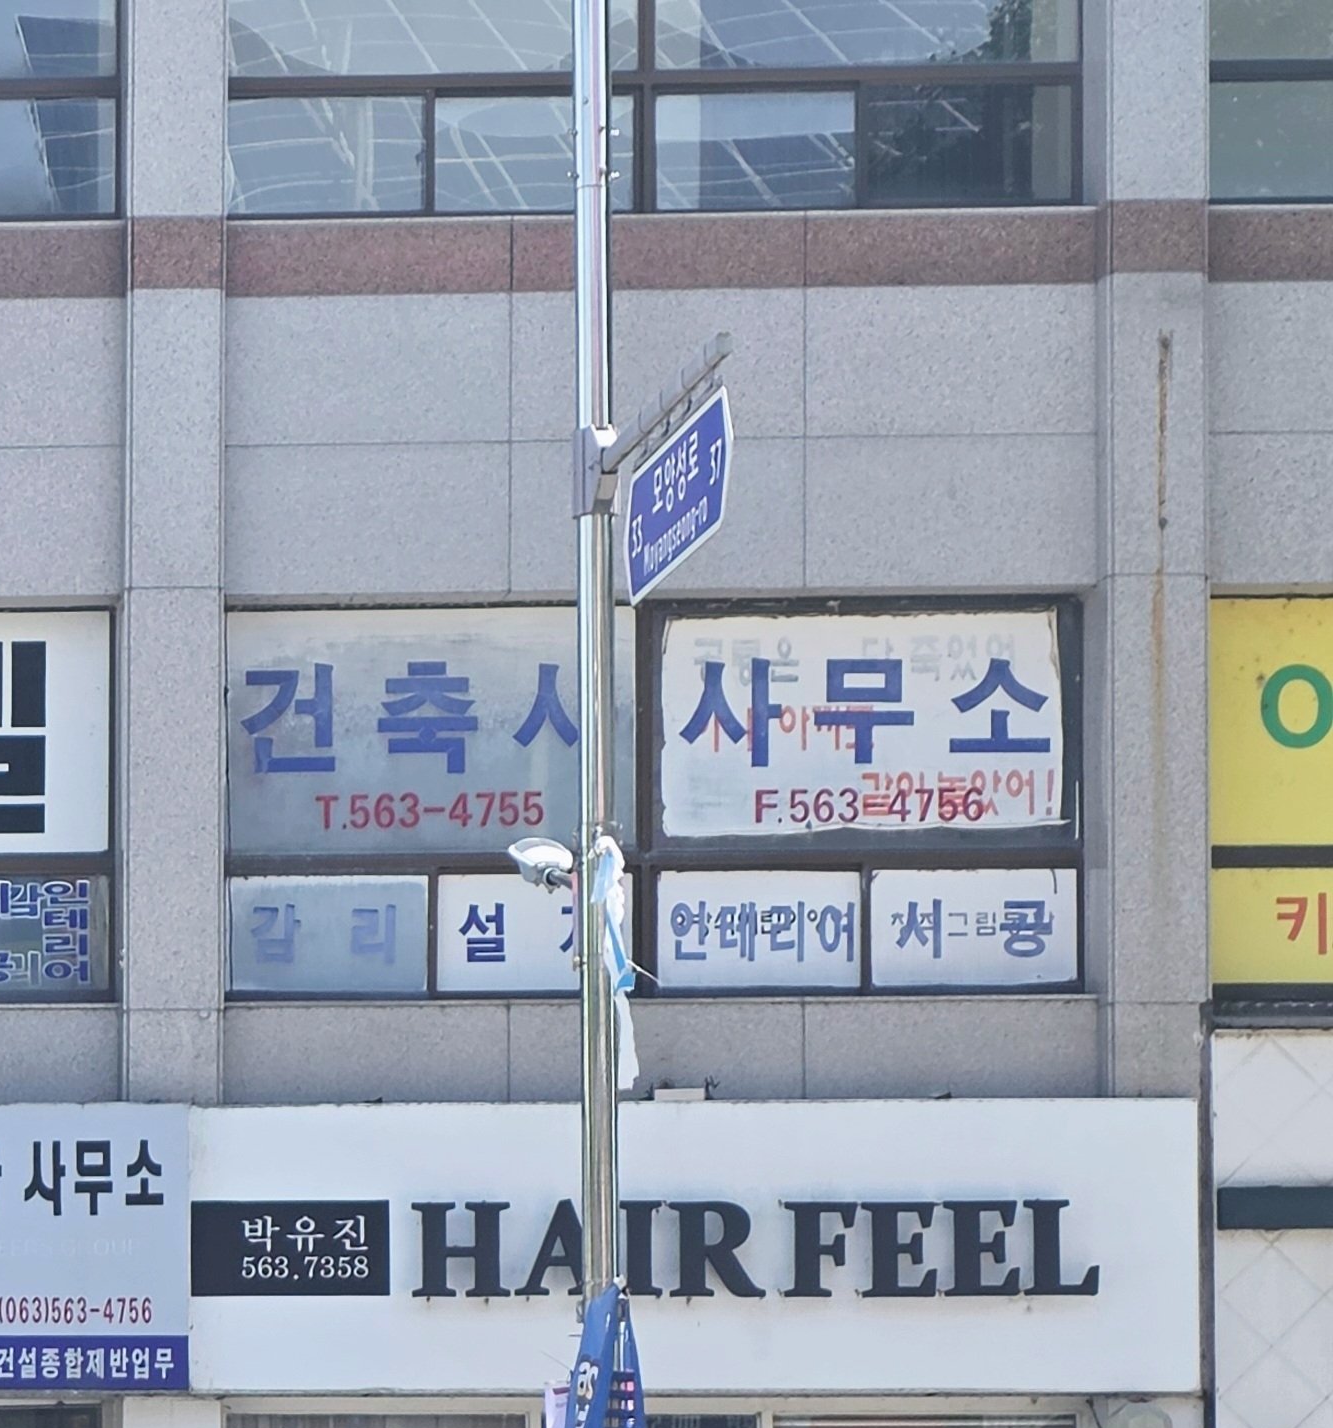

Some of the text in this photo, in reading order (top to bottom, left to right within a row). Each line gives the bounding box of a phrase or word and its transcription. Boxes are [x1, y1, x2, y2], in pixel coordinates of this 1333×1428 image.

[652, 431, 699, 513] 모양성로
[710, 439, 722, 486] 37
[632, 514, 643, 557] 33
[643, 497, 708, 576] Moyangseong-ro
[680, 658, 1051, 767] 사무소
[315, 790, 545, 830] T.563-4755
[754, 788, 985, 823] F.563-4756
[42, 880, 90, 984] 인테리어
[251, 903, 396, 965] 감리
[24, 1138, 164, 1217] 사무소
[240, 1216, 371, 1252] 박유진
[411, 1199, 1100, 1298] HAIR FEEL
[240, 1254, 371, 1281] 563.7358
